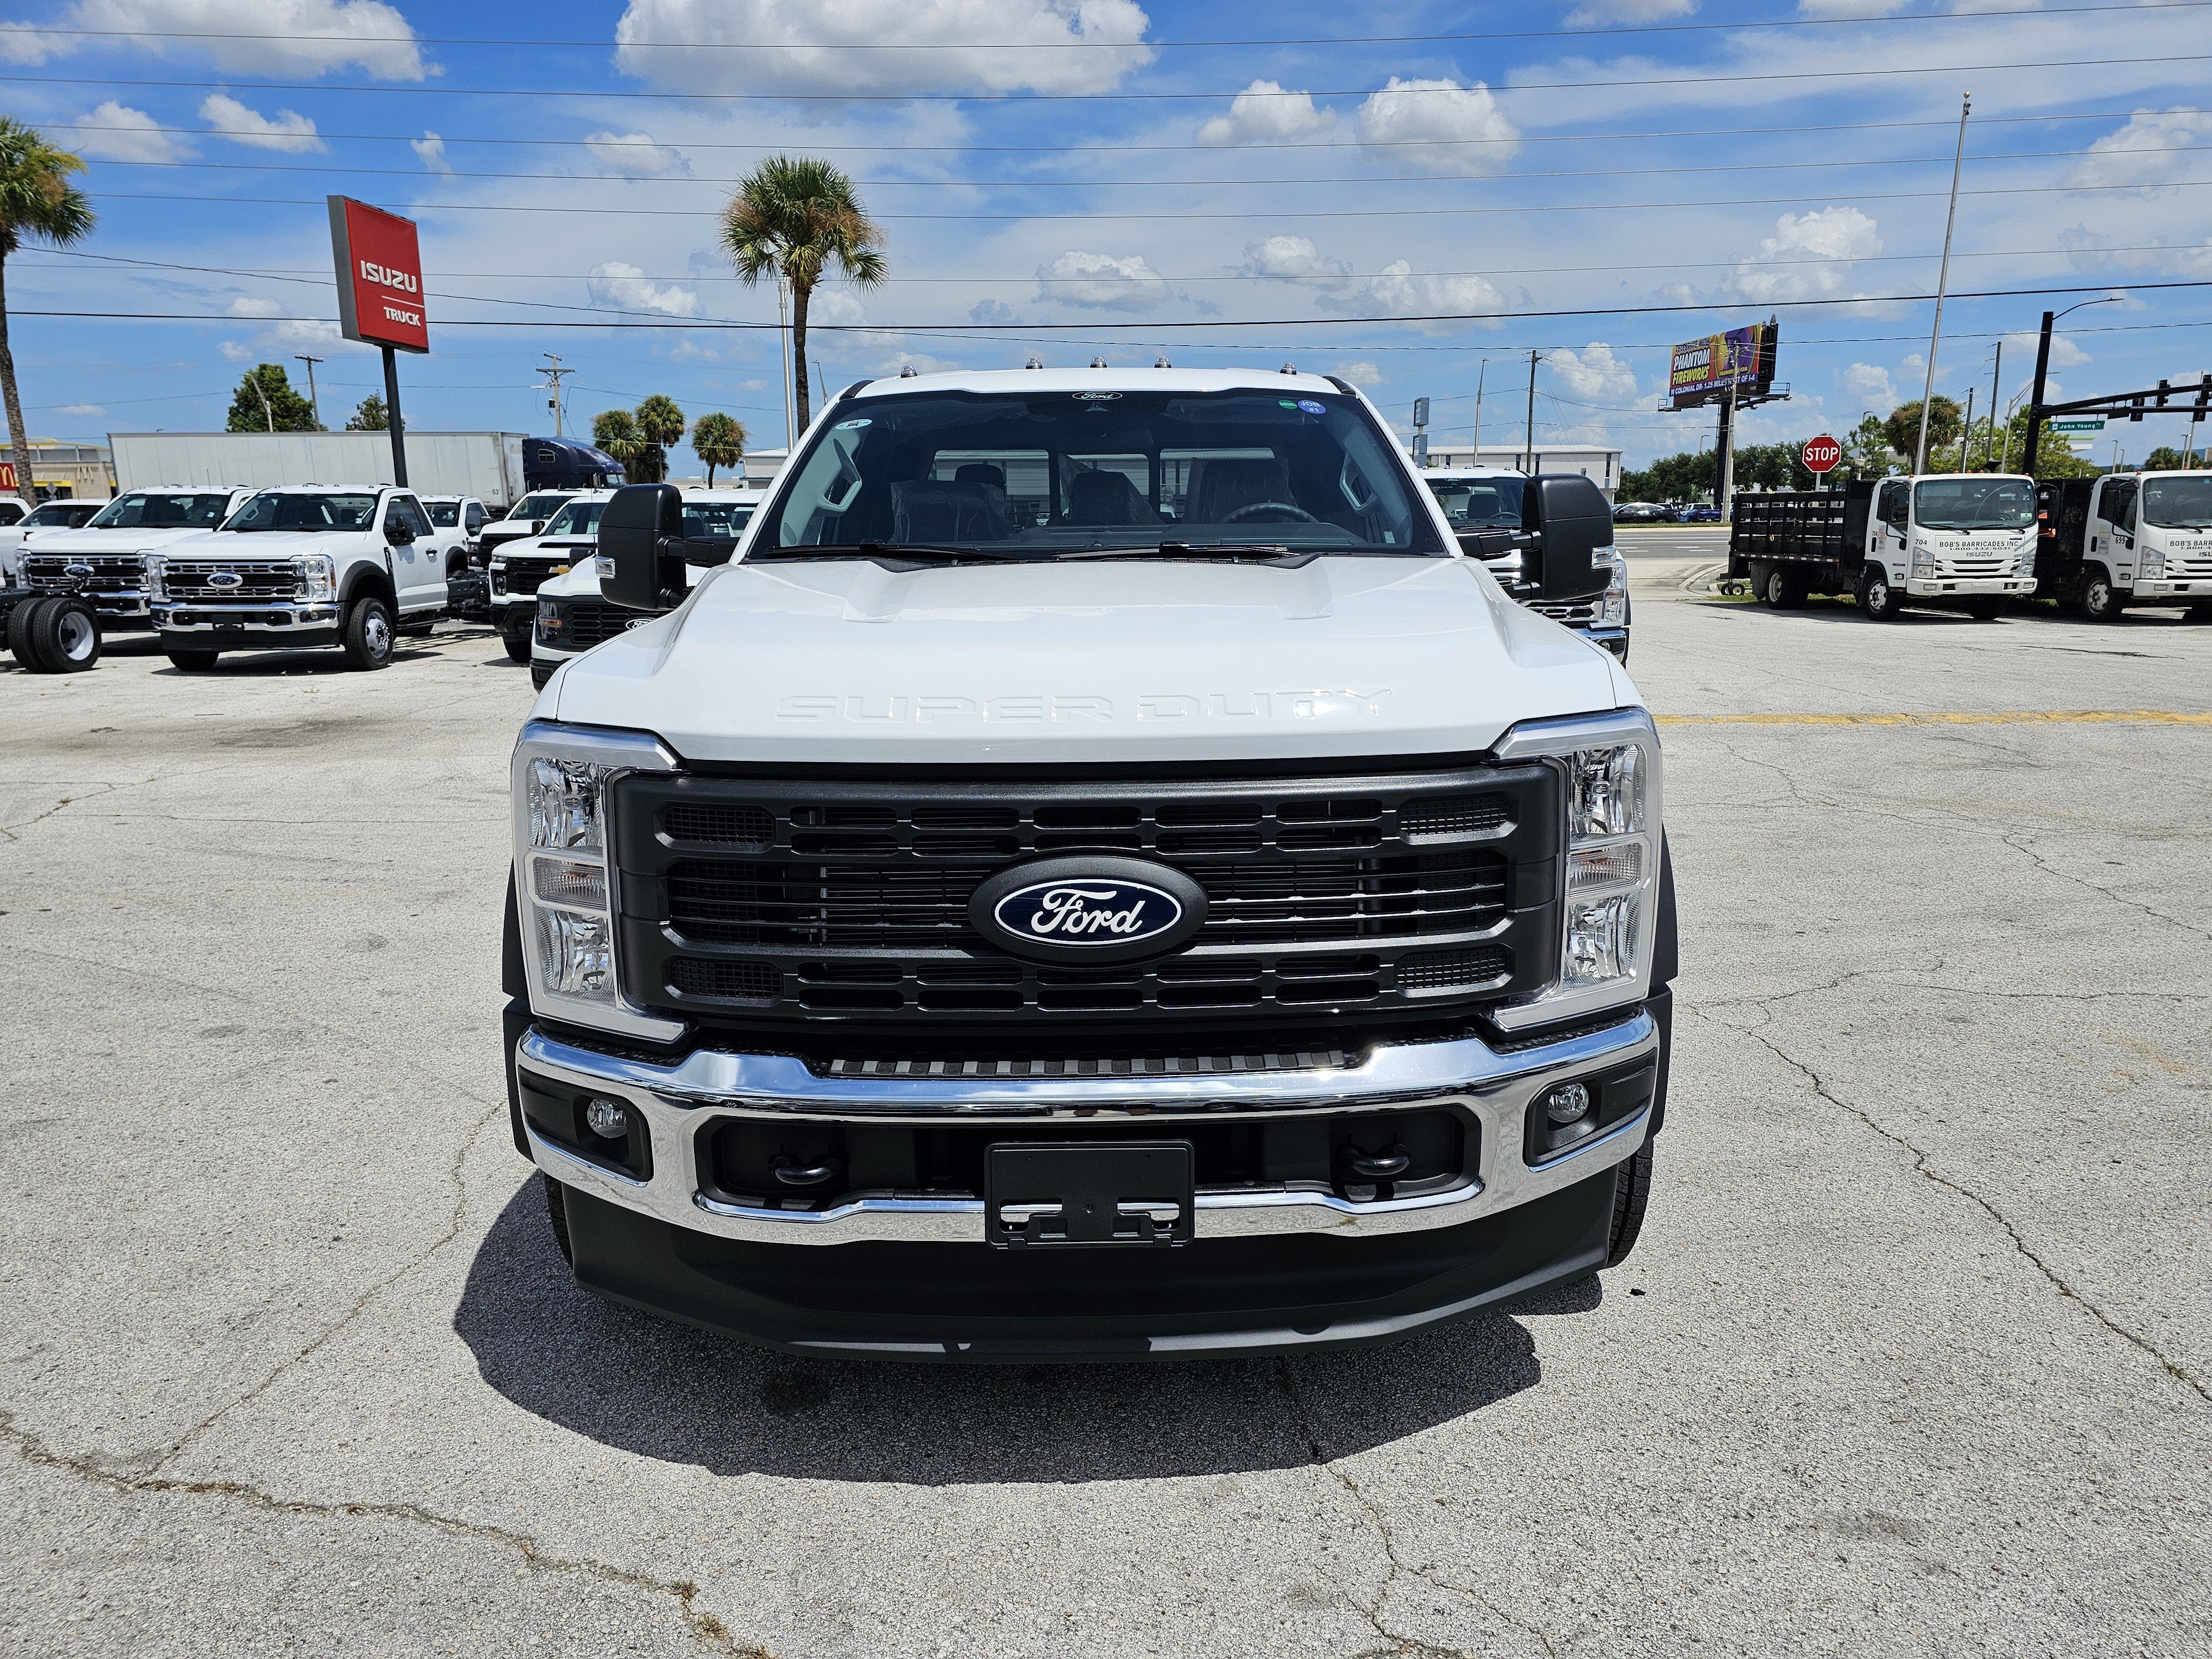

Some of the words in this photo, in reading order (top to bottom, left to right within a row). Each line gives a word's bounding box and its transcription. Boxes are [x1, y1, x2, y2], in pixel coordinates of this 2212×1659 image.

[361, 260, 417, 293] ISUZU
[383, 306, 421, 327] TRUCK
[1673, 348, 1710, 371] PHANTOM
[1672, 365, 1710, 385] FIREWORKS
[1675, 384, 1695, 394] COLONIAL
[1741, 374, 1748, 383] OF
[1806, 447, 1839, 461] STOP
[776, 695, 1114, 723] SUPER
[1136, 688, 1394, 722] DUTY
[1031, 888, 1146, 933] Ford
